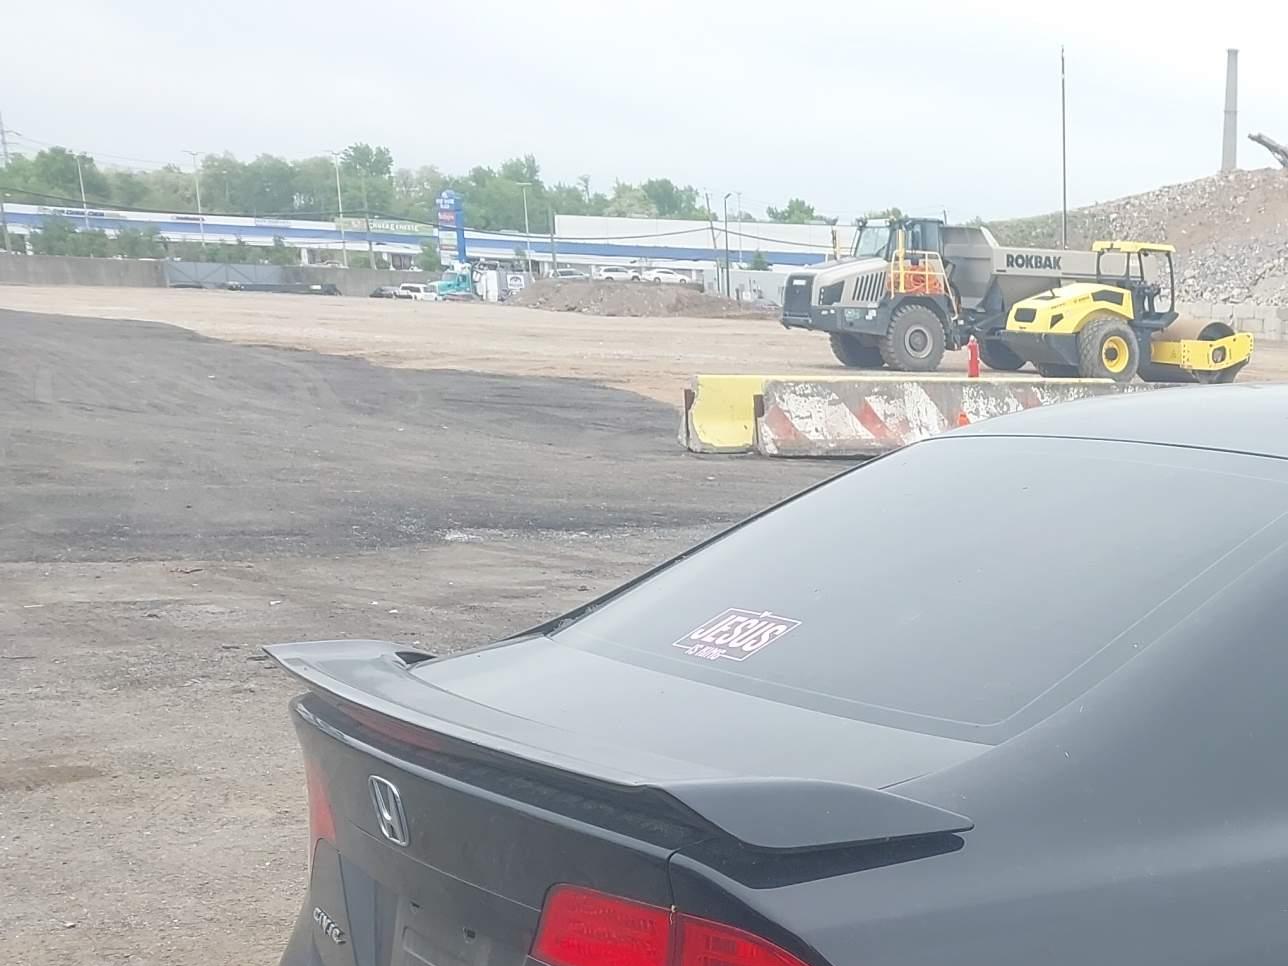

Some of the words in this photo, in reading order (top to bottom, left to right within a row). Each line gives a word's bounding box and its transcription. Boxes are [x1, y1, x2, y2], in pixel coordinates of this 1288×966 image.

[1006, 254, 1061, 270] ROKBAK
[690, 615, 788, 652] JESUS
[313, 907, 346, 944] CIVIC
